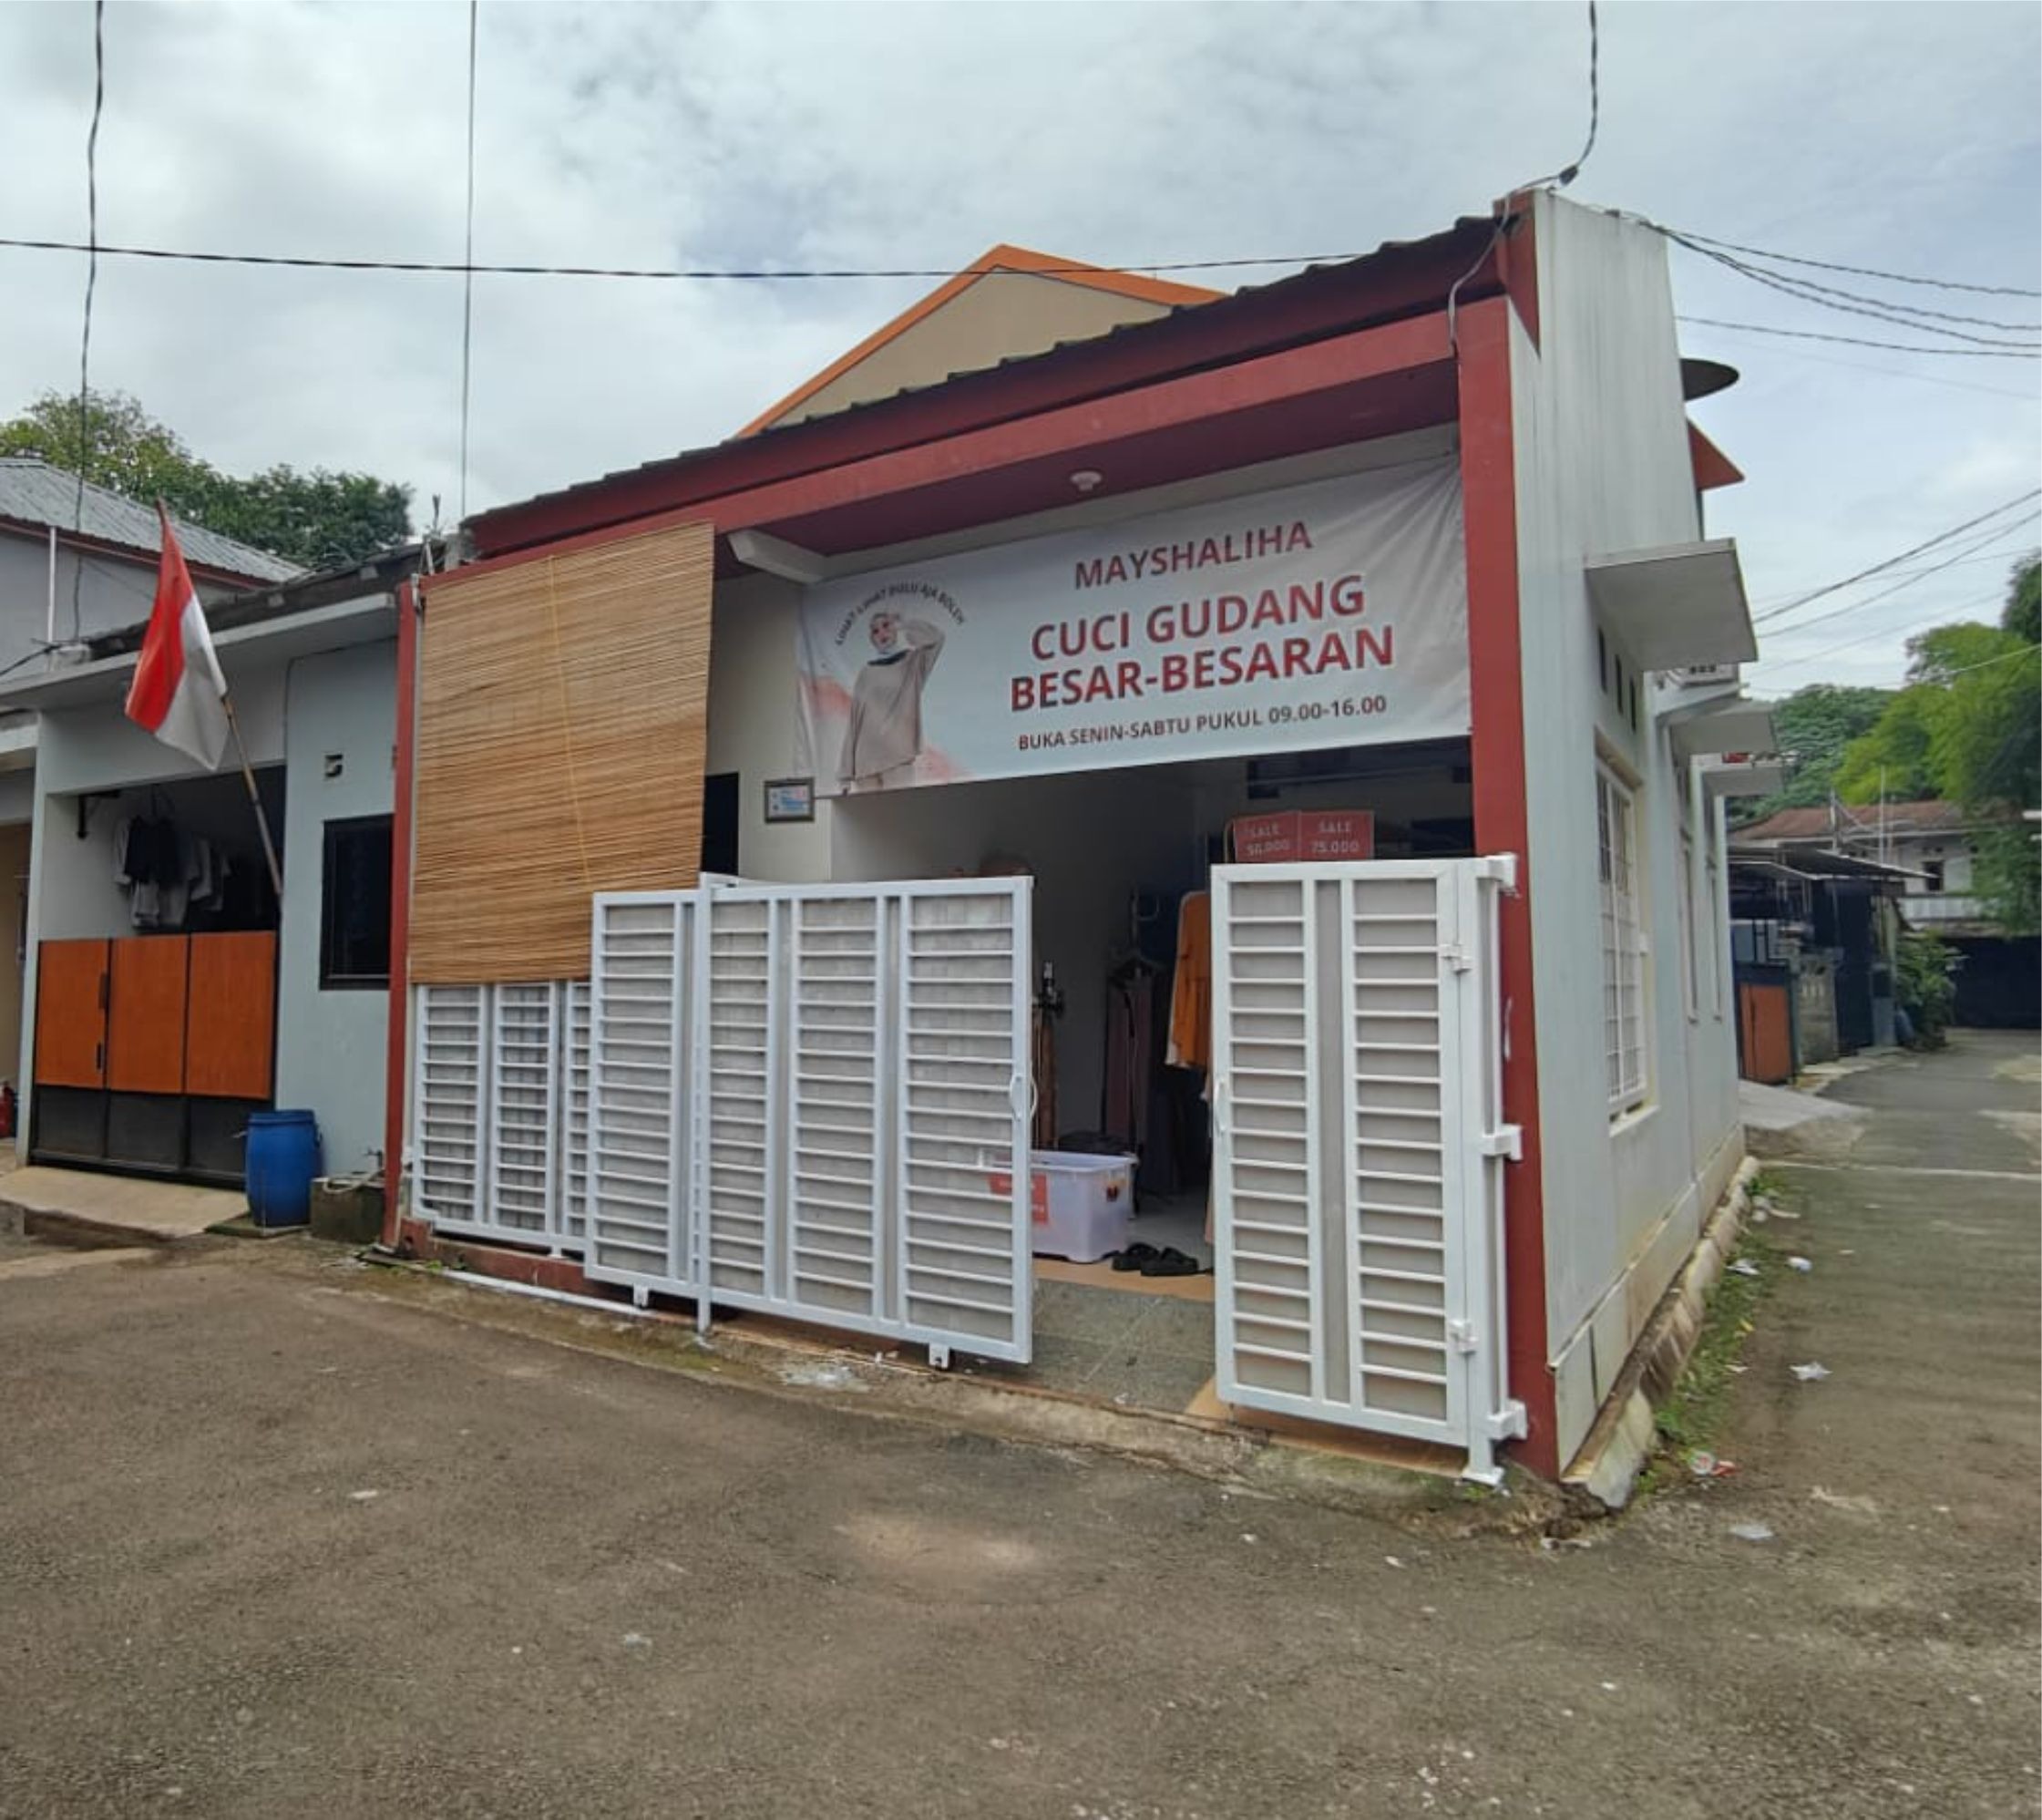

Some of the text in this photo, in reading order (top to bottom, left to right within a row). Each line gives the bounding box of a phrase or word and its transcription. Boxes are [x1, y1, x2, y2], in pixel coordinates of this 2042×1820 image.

[1073, 520, 1313, 590] MAYSHALIHA
[1031, 574, 1365, 662] CUCI GUDANG
[1011, 624, 1393, 713] BESAR-BESARAN
[1019, 694, 1387, 751] BUKA SENIN-SABTU PUKUL 09.00-16.00
[1310, 839, 1360, 854] 75.000
[1319, 819, 1351, 833] SALE
